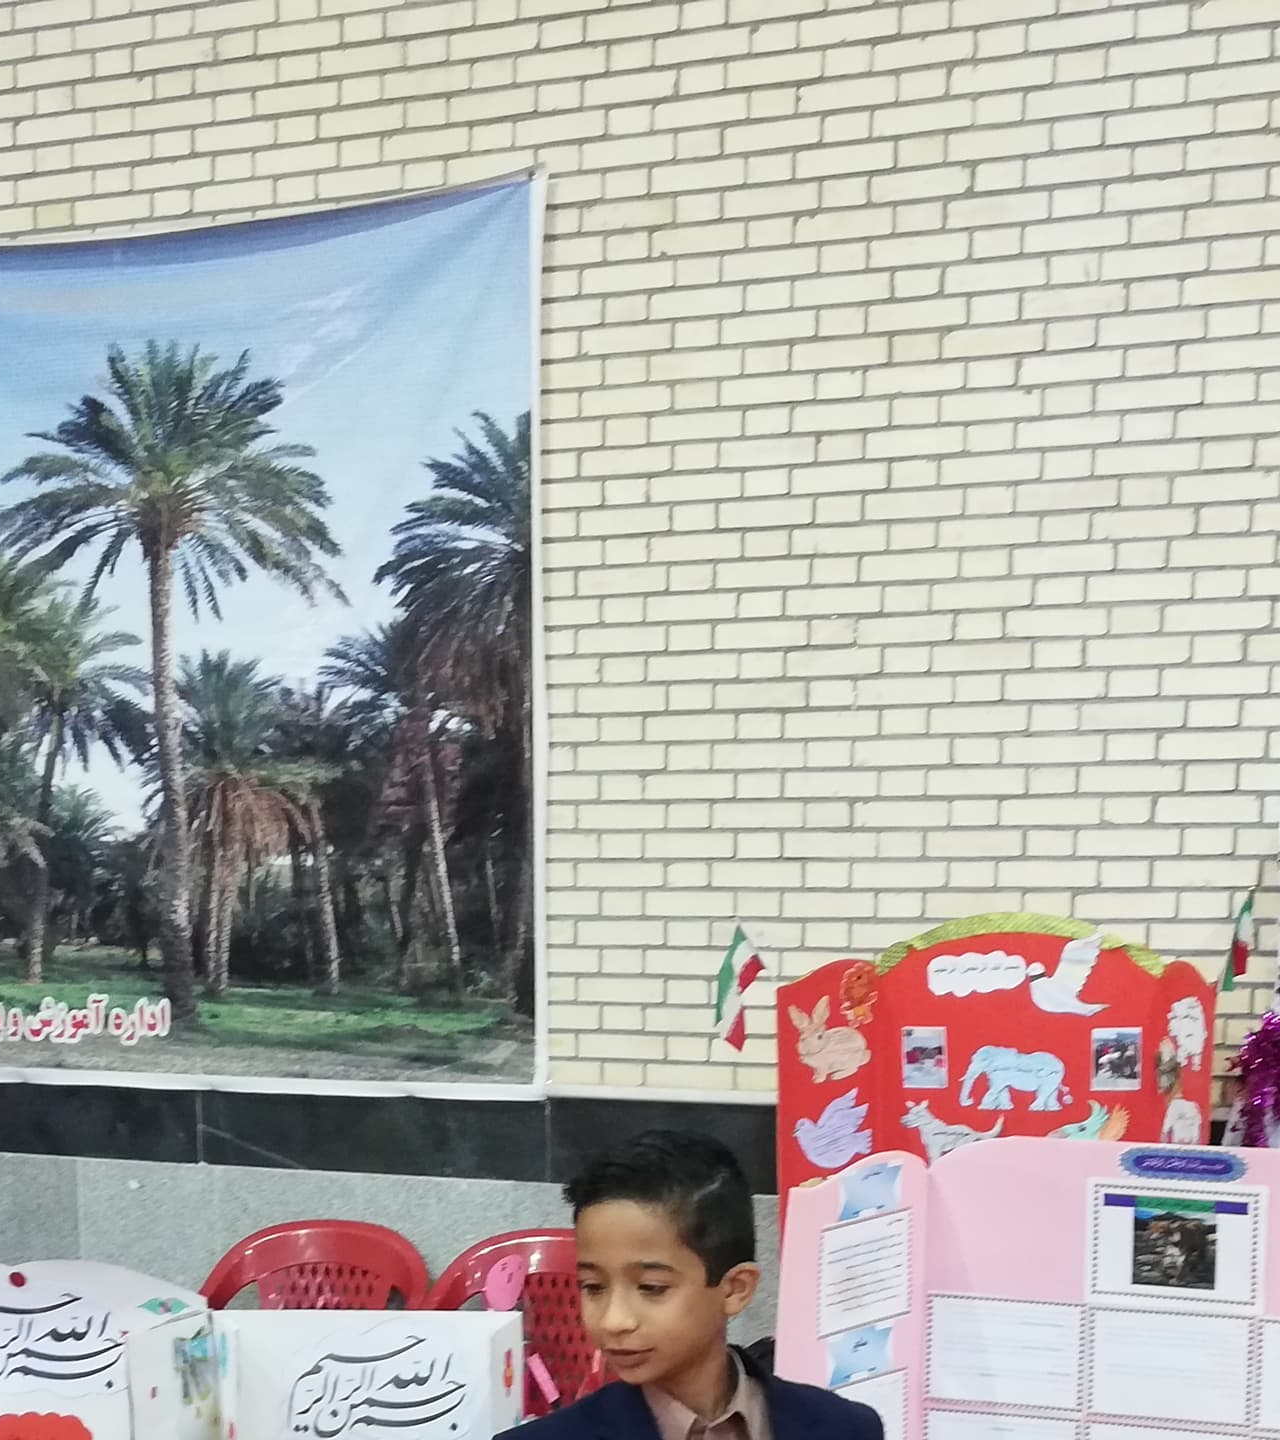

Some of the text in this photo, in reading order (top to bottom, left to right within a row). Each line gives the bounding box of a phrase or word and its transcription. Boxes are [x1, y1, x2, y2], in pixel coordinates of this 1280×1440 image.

[7, 1007, 24, 1041] و
[25, 993, 109, 1043] آموزش
[108, 996, 171, 1045] اداره
[34, 1311, 111, 1342] الله
[376, 1353, 453, 1391] الله
